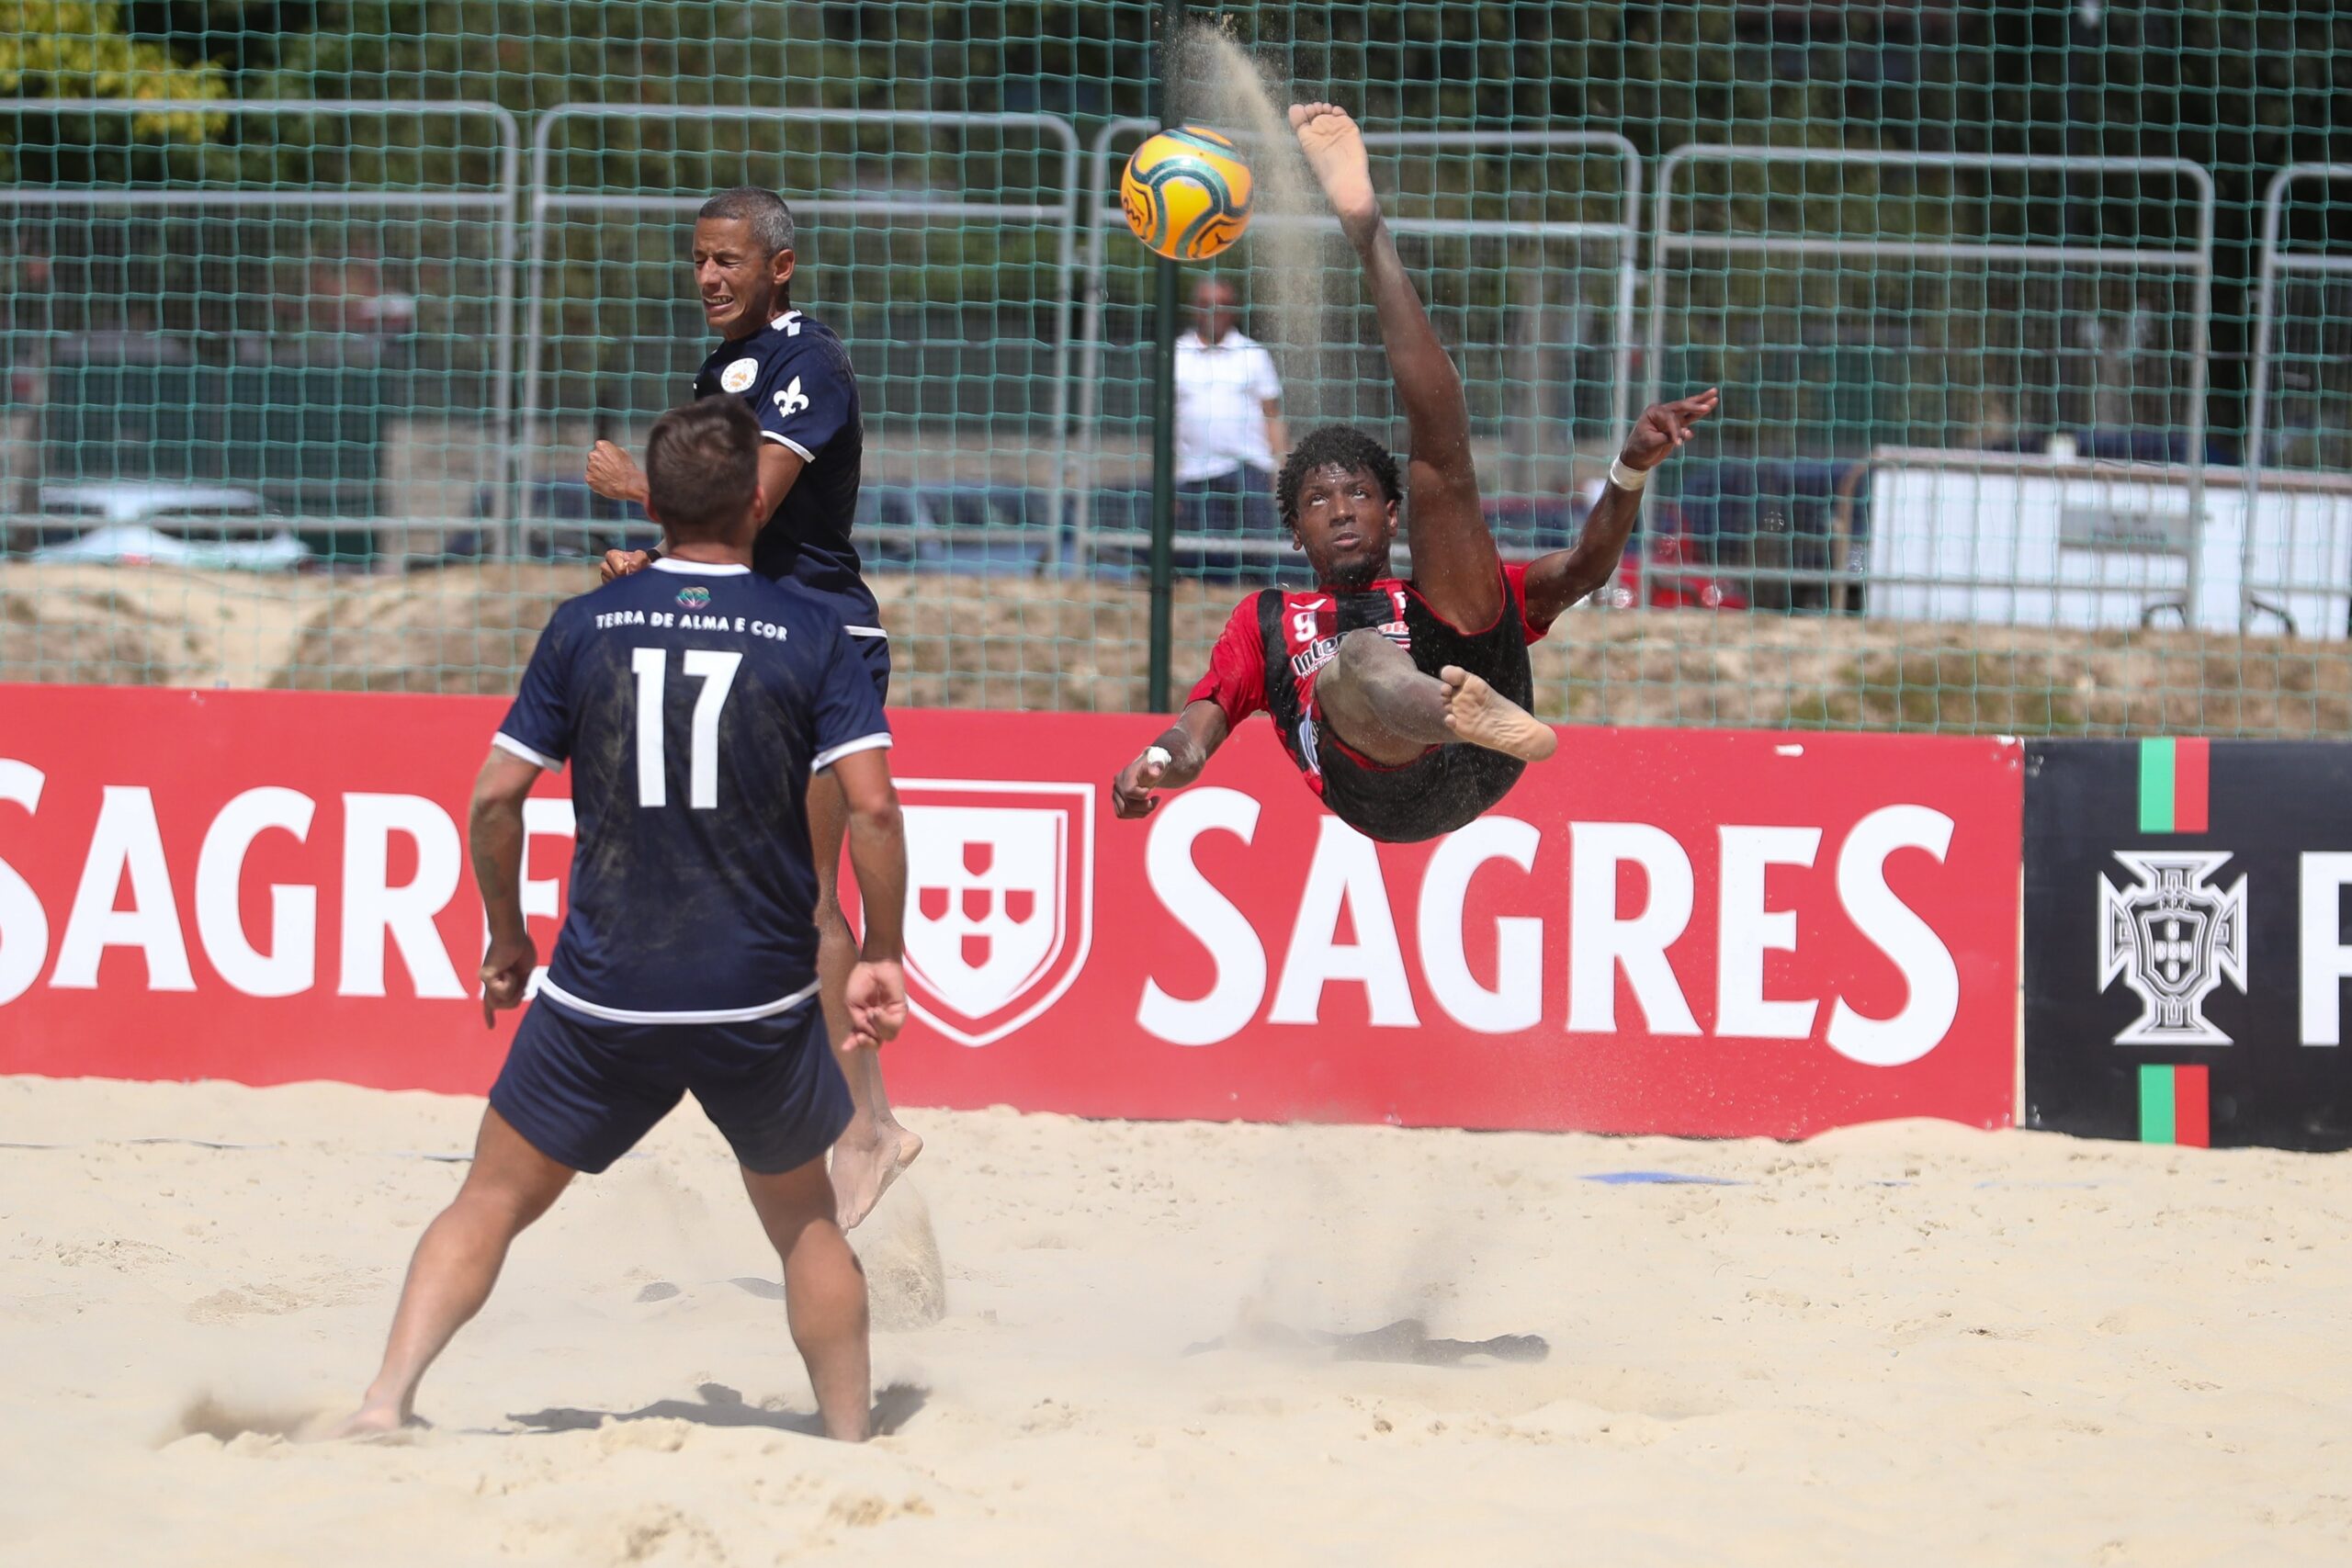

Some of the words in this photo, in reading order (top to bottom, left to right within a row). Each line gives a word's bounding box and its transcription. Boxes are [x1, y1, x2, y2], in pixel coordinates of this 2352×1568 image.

[595, 610, 645, 630] TERRA
[650, 612, 675, 628] DE
[678, 614, 729, 632] ALMA
[734, 617, 746, 633] E
[750, 620, 788, 642] COR
[631, 647, 743, 809] 17
[1136, 786, 1960, 1066] SAGRES
